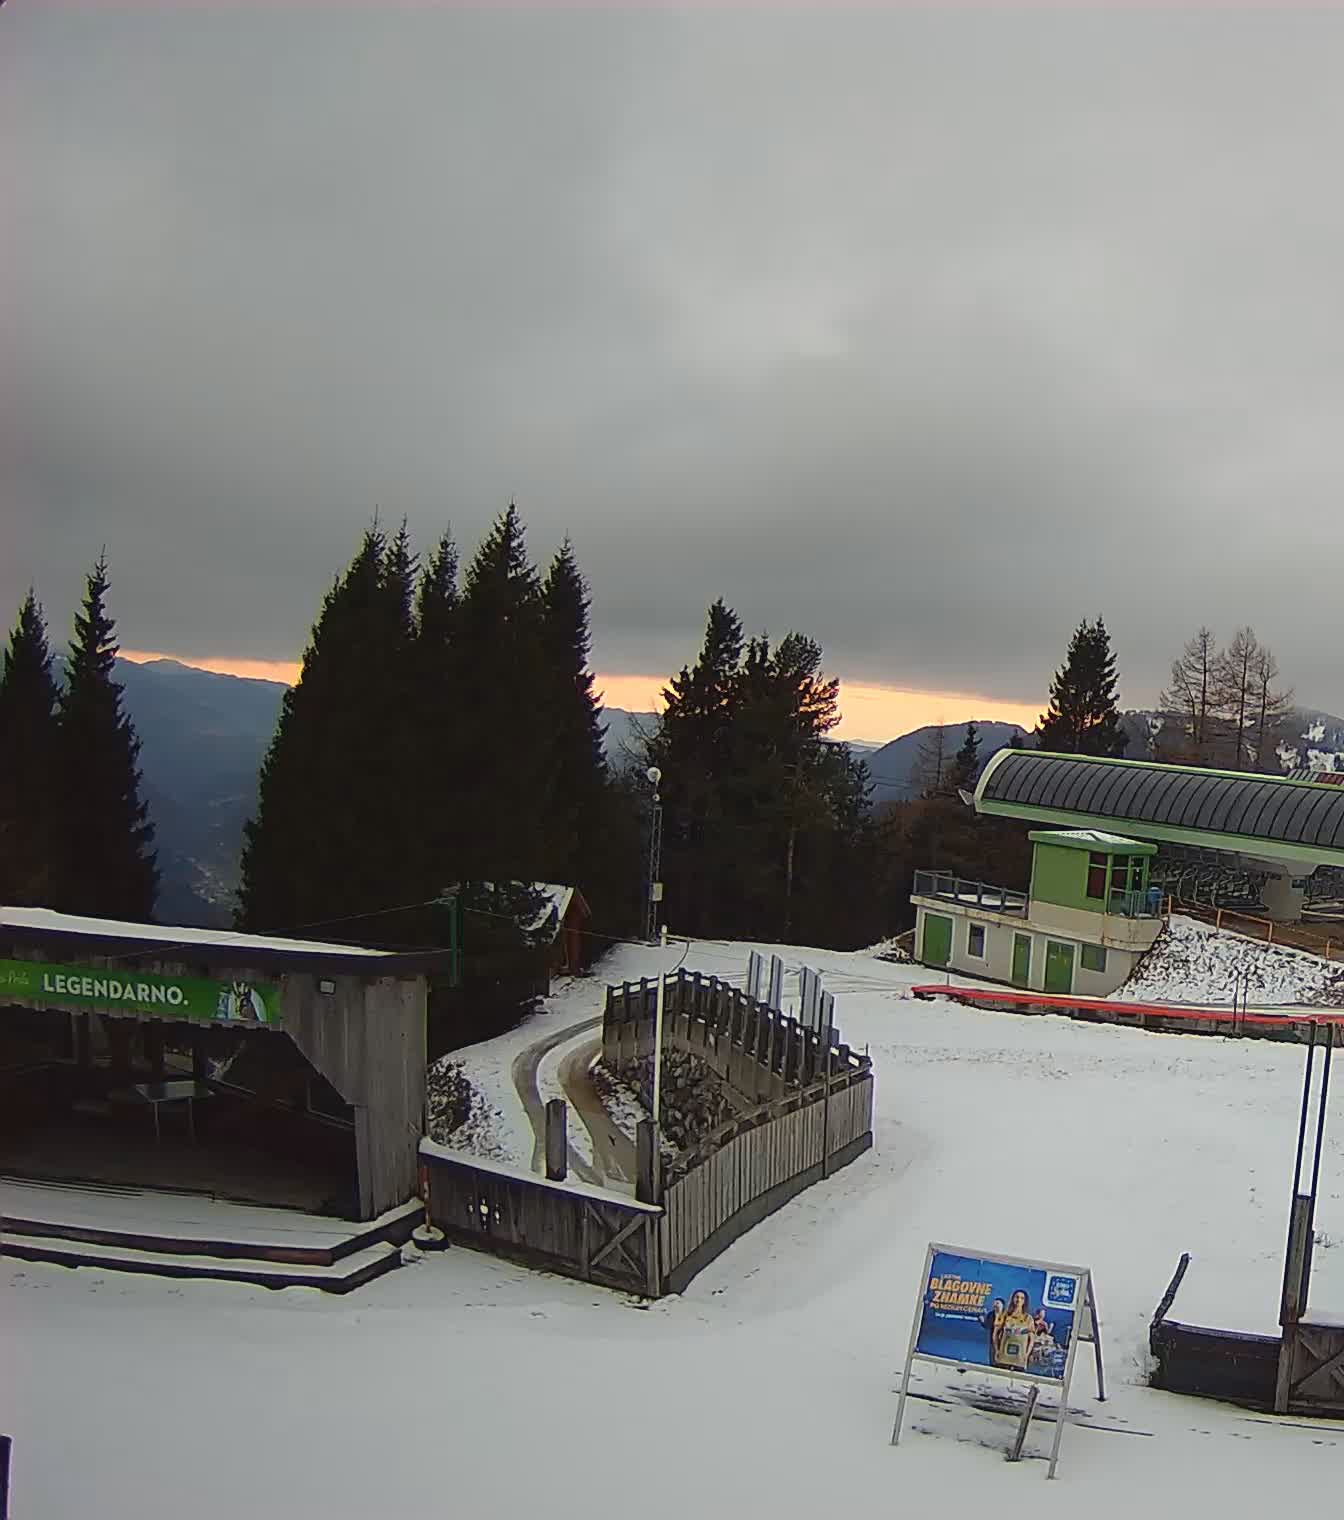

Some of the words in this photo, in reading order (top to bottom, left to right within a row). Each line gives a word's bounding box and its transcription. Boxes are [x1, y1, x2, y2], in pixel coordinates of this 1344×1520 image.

[43, 974, 189, 1005] LEGENDARNO.
[930, 1278, 992, 1295] BLAGOVNE
[932, 1291, 985, 1306] ZNAMKE
